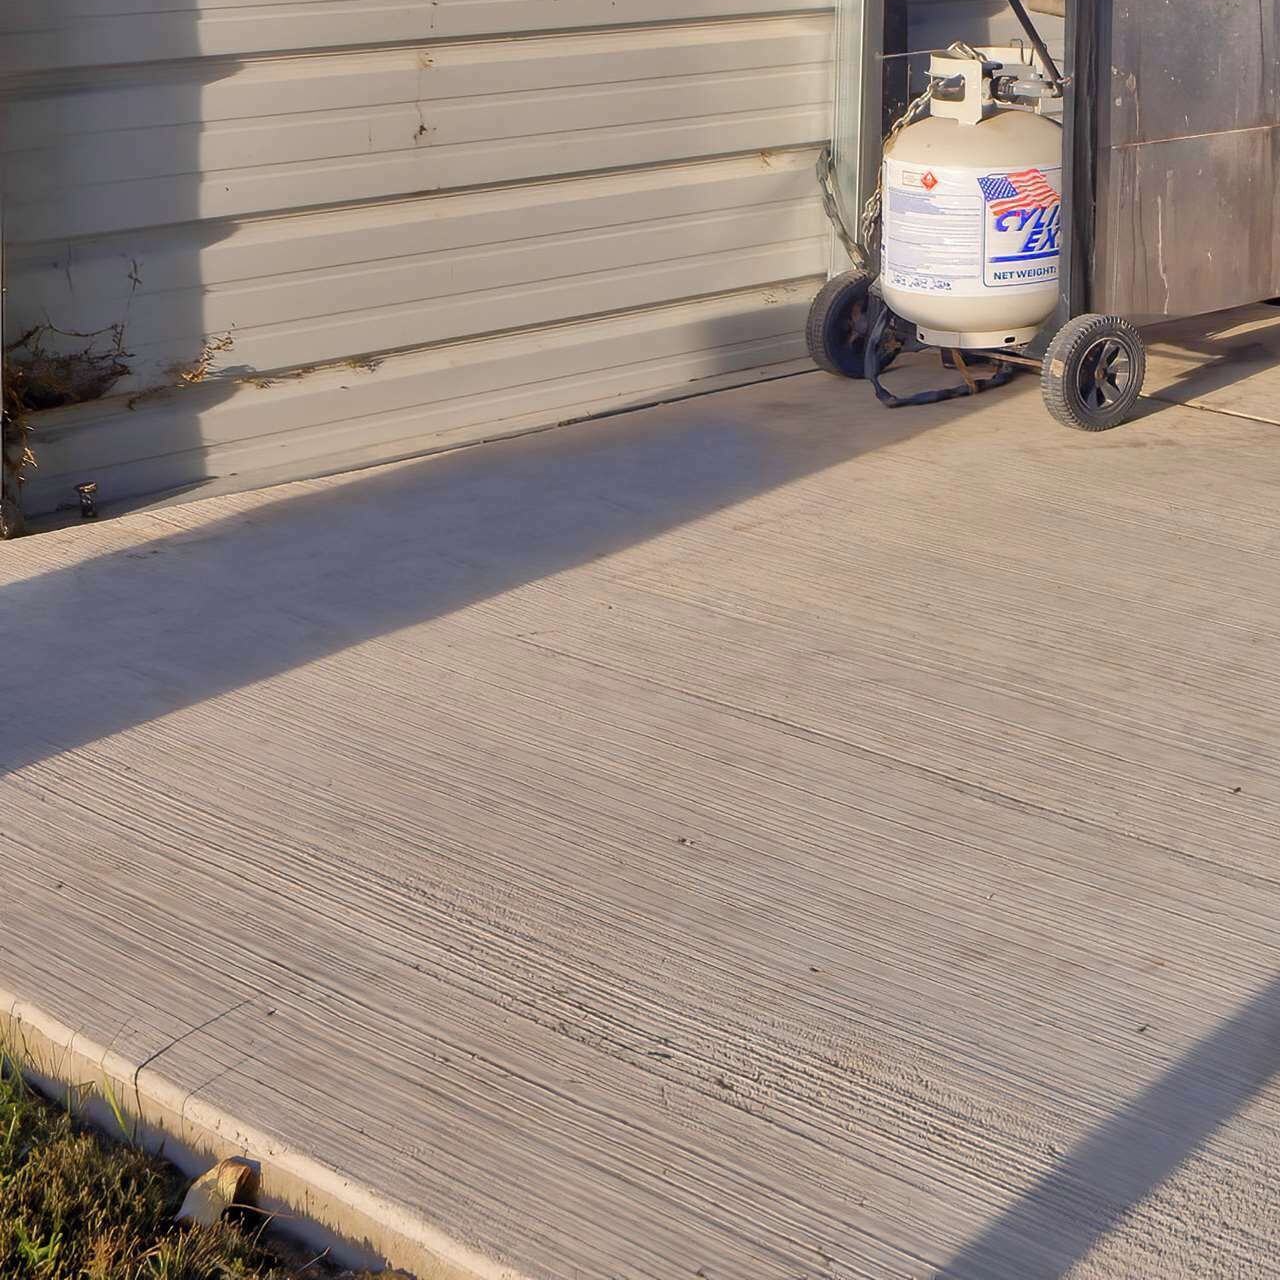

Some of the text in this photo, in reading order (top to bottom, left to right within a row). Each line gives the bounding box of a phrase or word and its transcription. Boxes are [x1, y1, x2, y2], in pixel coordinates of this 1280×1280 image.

[995, 204, 1060, 232] CYLI
[1021, 228, 1060, 252] EX
[993, 271, 1014, 280] NET
